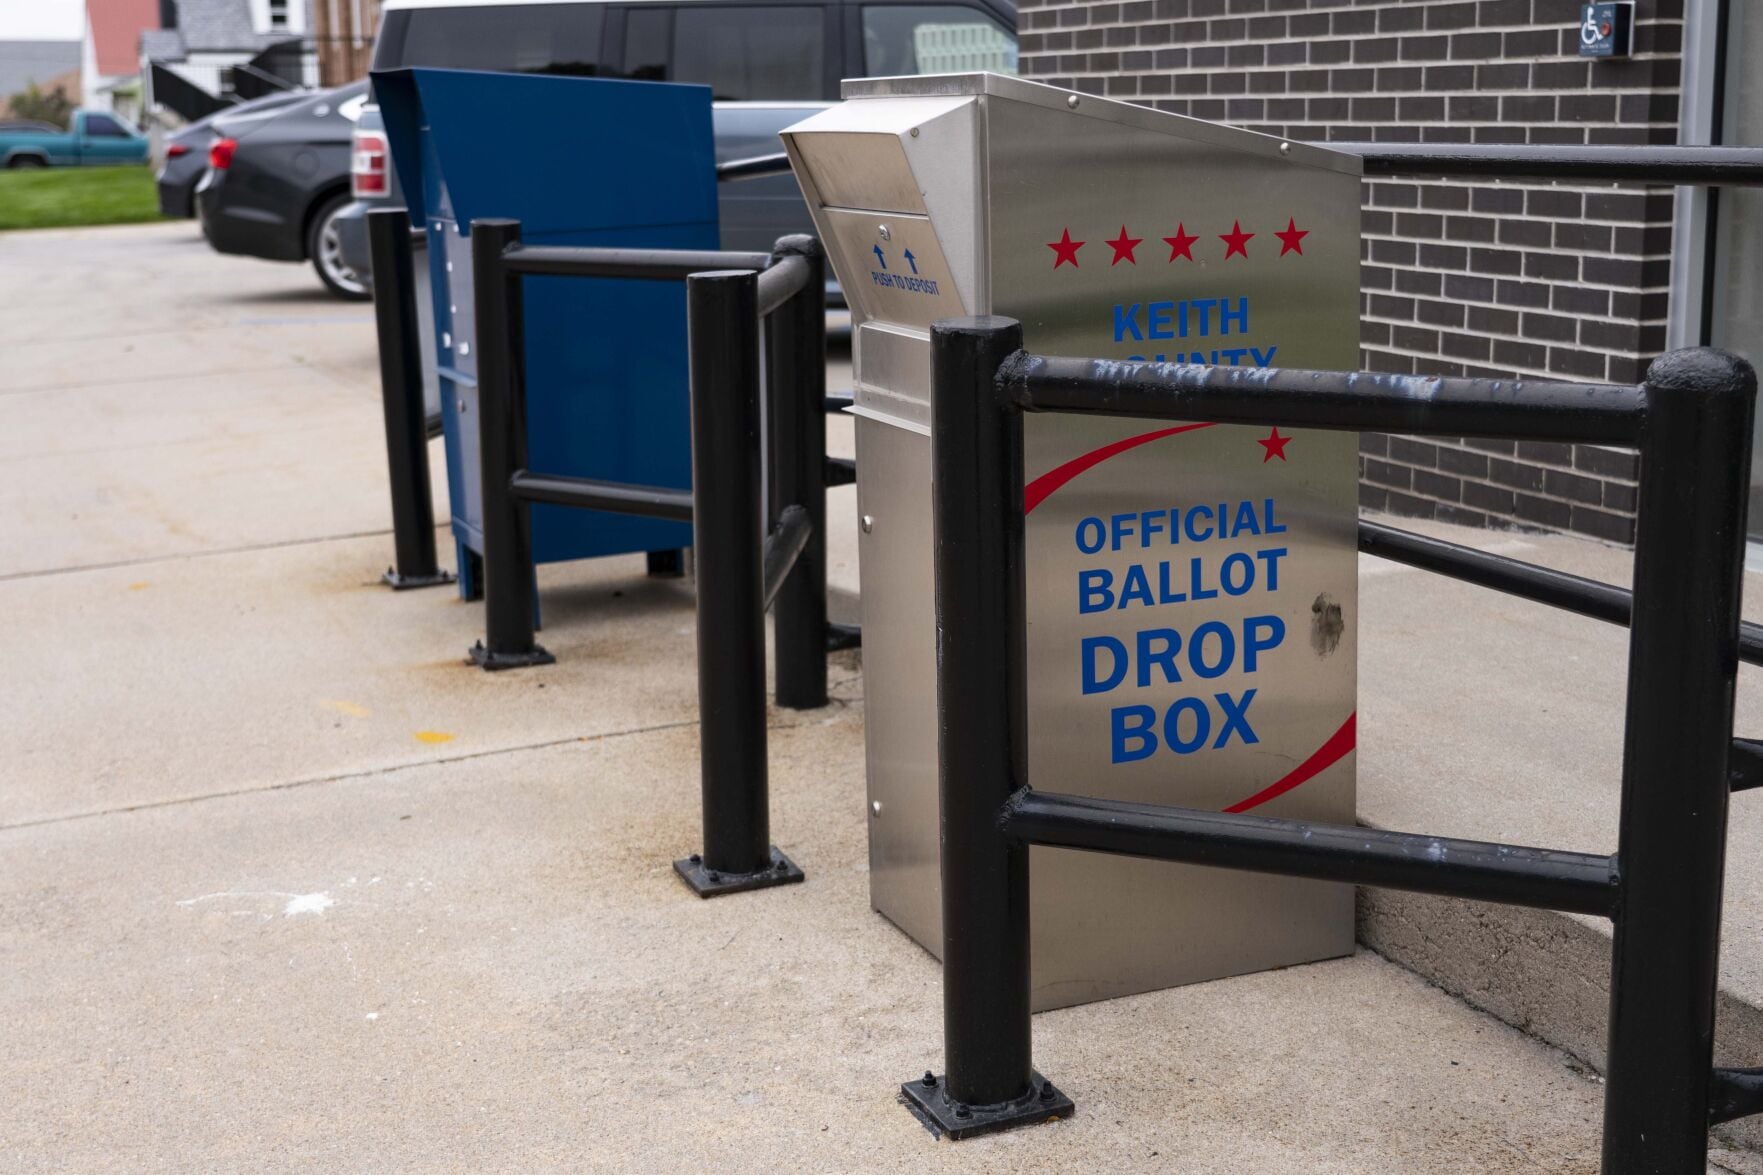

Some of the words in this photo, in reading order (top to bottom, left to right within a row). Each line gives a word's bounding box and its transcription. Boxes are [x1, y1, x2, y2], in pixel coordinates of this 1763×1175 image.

[871, 271, 894, 287] PUSH
[892, 274, 905, 289] TO
[904, 276, 940, 296] DEPOSIT
[1113, 296, 1249, 343] KEITH
[1075, 498, 1288, 555] OFFICIAL
[1078, 547, 1288, 615] BALLOT
[1081, 614, 1286, 695] DROP
[1110, 688, 1260, 764] BOX
